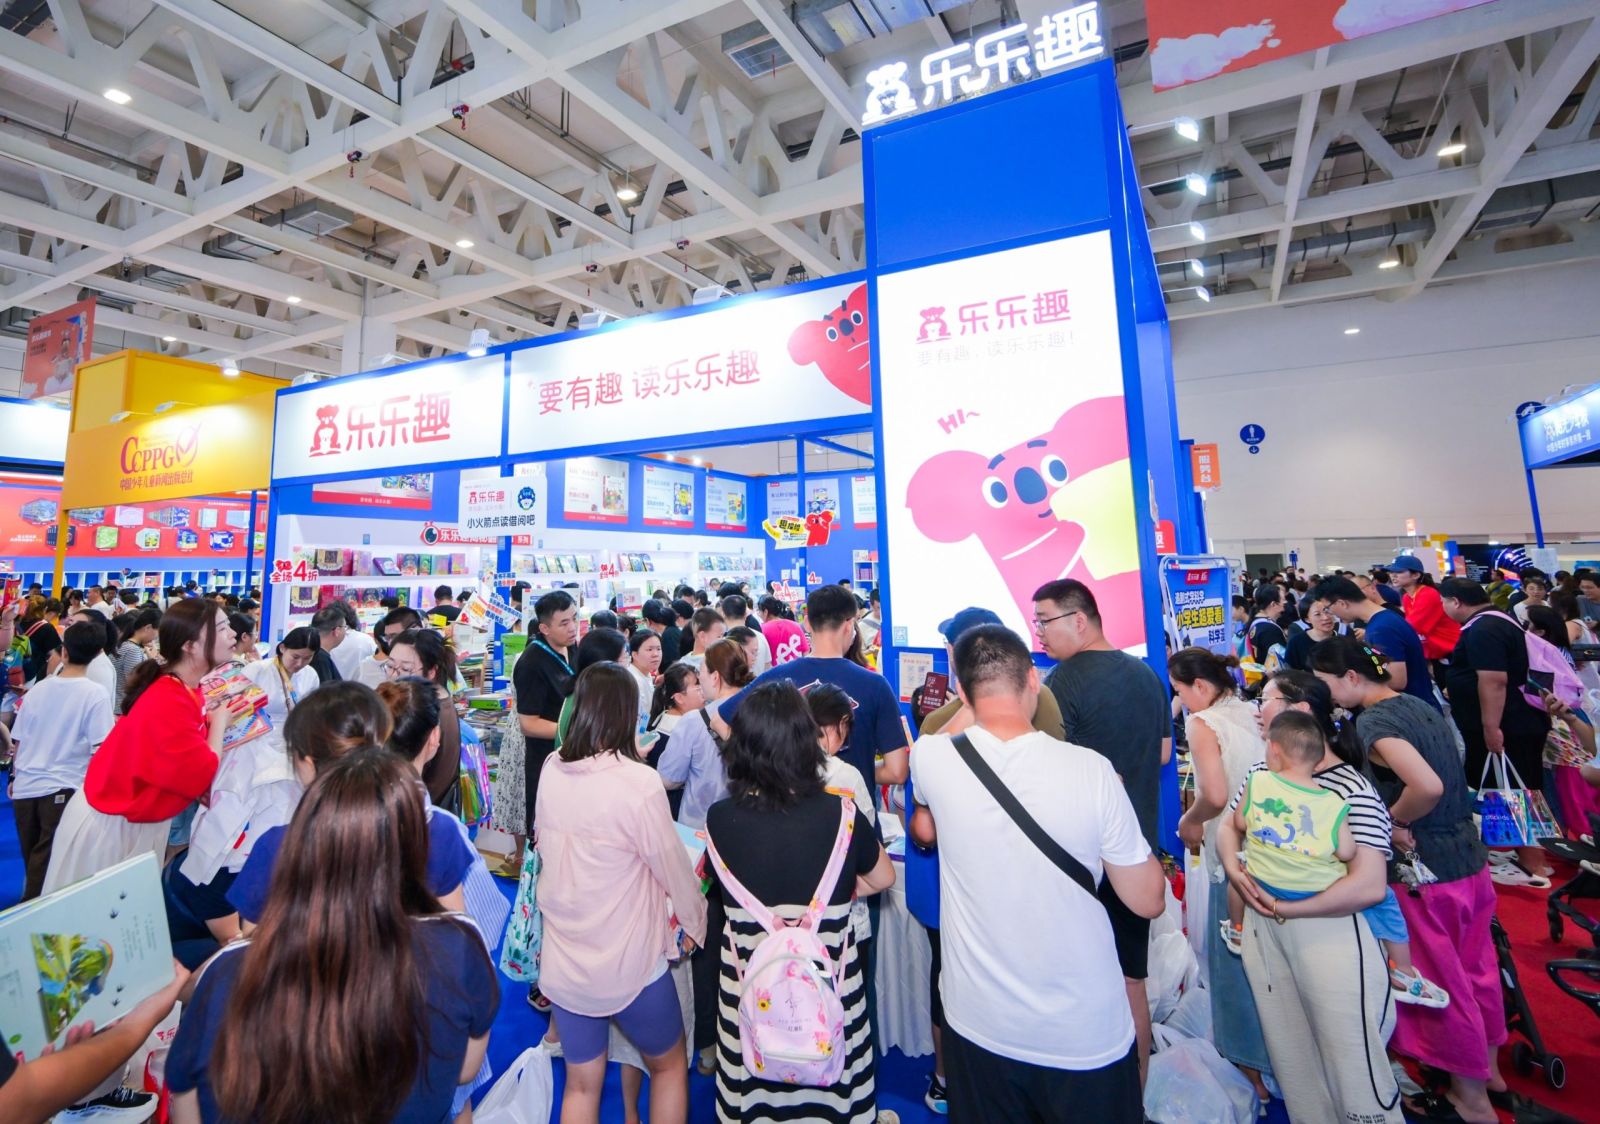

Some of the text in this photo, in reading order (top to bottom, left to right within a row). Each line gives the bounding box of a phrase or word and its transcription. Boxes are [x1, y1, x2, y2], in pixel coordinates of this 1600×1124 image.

[920, 1, 1104, 105] 乐乐趣
[958, 288, 1072, 336] 乐乐趣
[537, 349, 761, 416] 要有趣 读乐乐趣
[346, 390, 451, 451] 乐乐趣
[478, 490, 505, 503] 乐乐趣
[466, 514, 536, 529] 小火箭点读借阅吧
[271, 560, 318, 583] 全场4折
